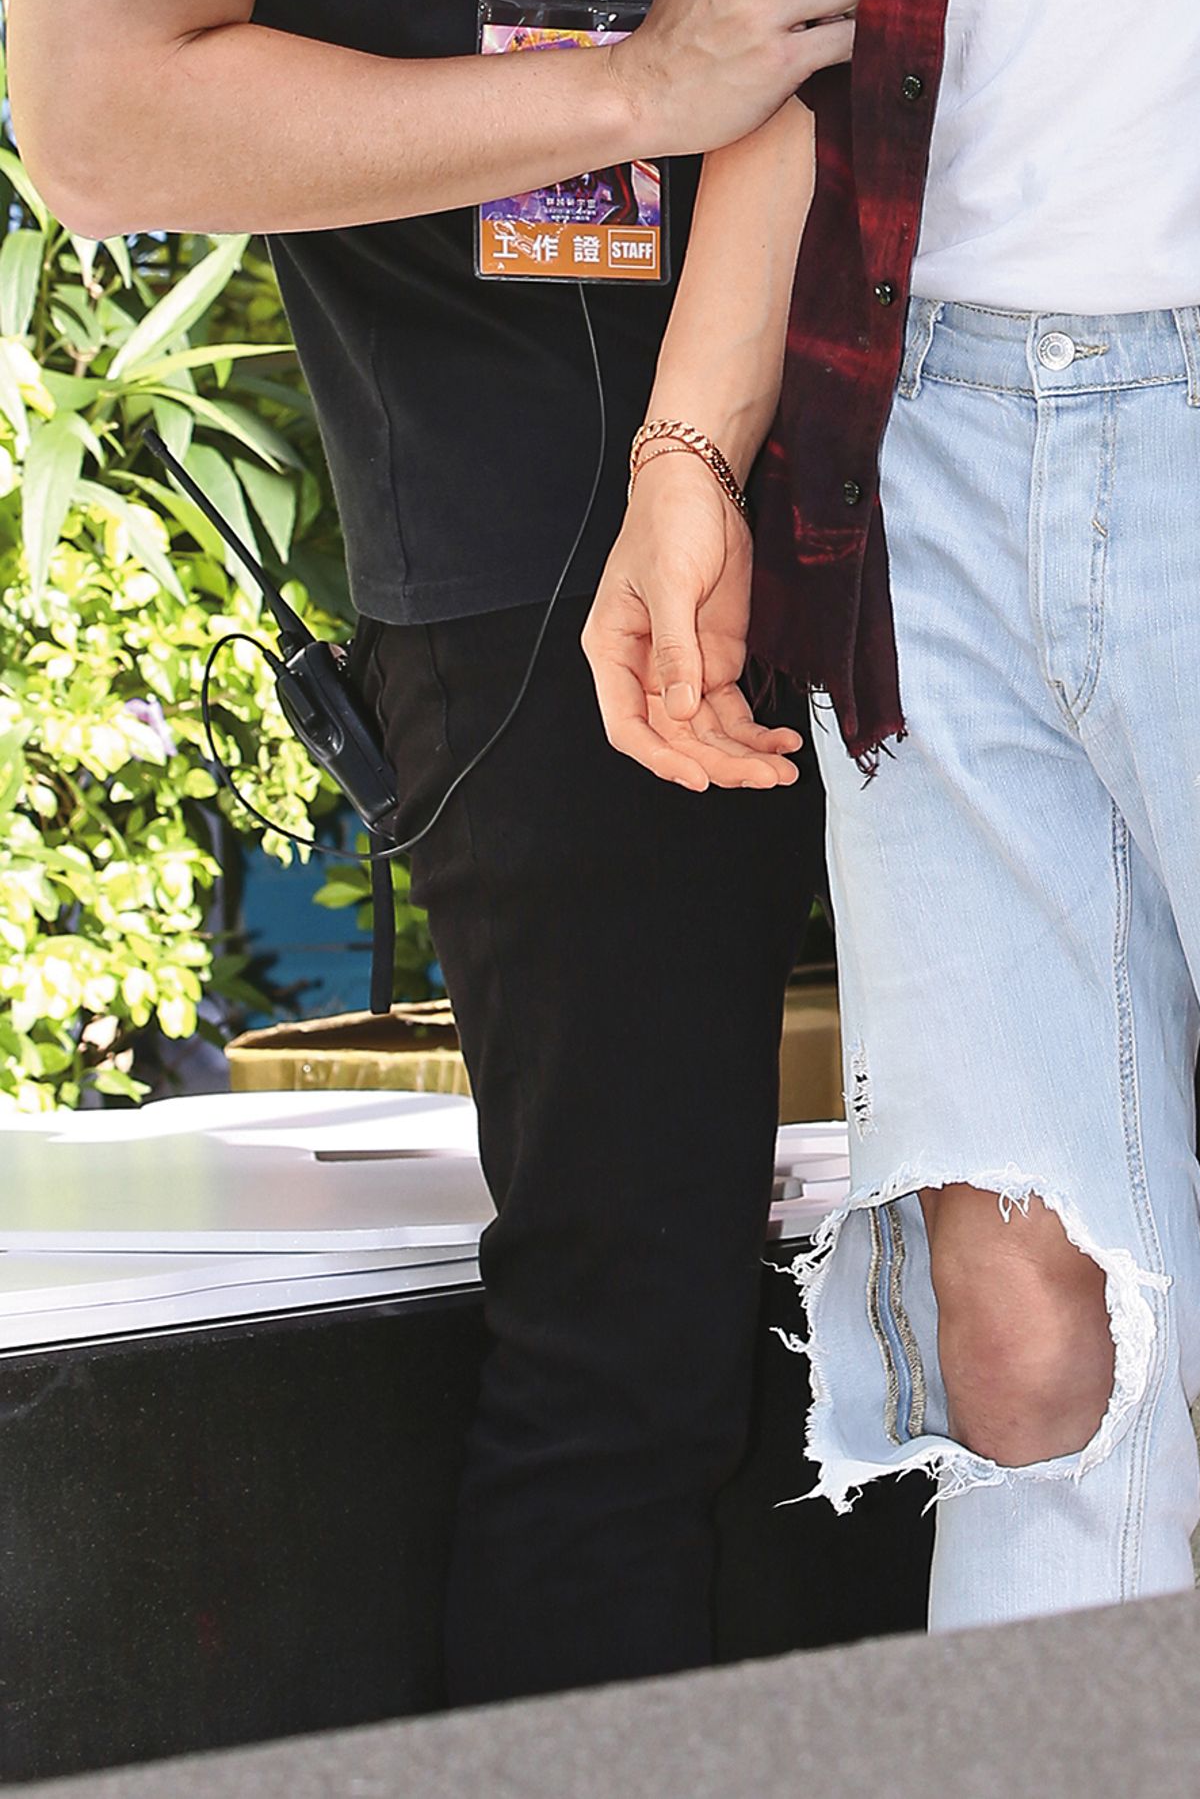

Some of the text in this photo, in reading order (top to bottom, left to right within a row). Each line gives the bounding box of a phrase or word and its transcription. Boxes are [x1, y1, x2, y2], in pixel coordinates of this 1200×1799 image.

[493, 234, 600, 263] 工作證
[611, 241, 653, 259] STAFF
